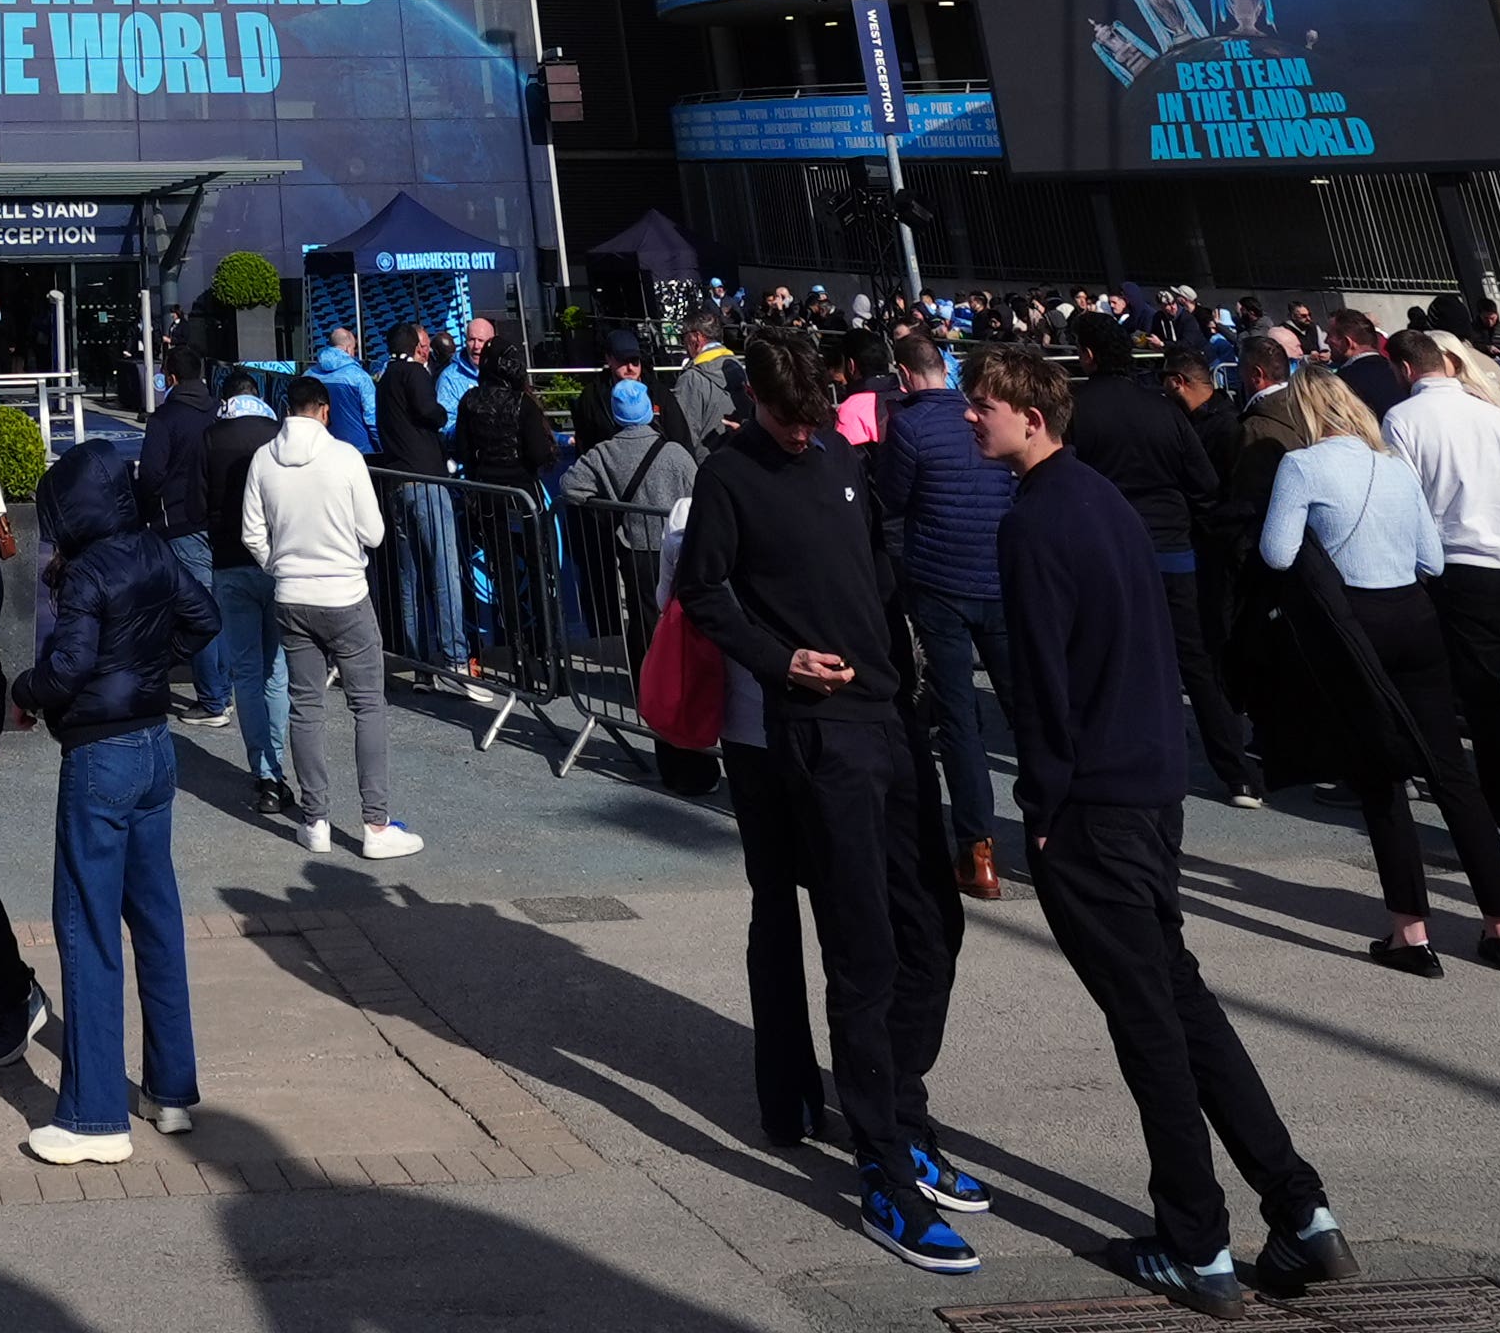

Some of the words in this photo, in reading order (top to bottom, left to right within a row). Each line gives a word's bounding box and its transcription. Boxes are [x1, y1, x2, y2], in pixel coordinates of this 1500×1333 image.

[866, 9, 882, 46] WEST
[48, 11, 282, 95] WORLD
[1220, 40, 1253, 59] THE
[873, 48, 895, 123] RECEPTION
[1176, 60, 1236, 91] BEST
[1238, 58, 1313, 88] TEAM
[1157, 93, 1186, 122] IN
[1187, 91, 1233, 122] THE
[1235, 88, 1306, 121] LAND
[1309, 92, 1346, 113] AND
[1151, 124, 1202, 160] ALL
[1202, 122, 1260, 158] THE
[1257, 117, 1375, 157] WORLD
[32, 201, 98, 219] STAND
[395, 252, 471, 271] MANCHESTER
[471, 252, 496, 270] CITY
